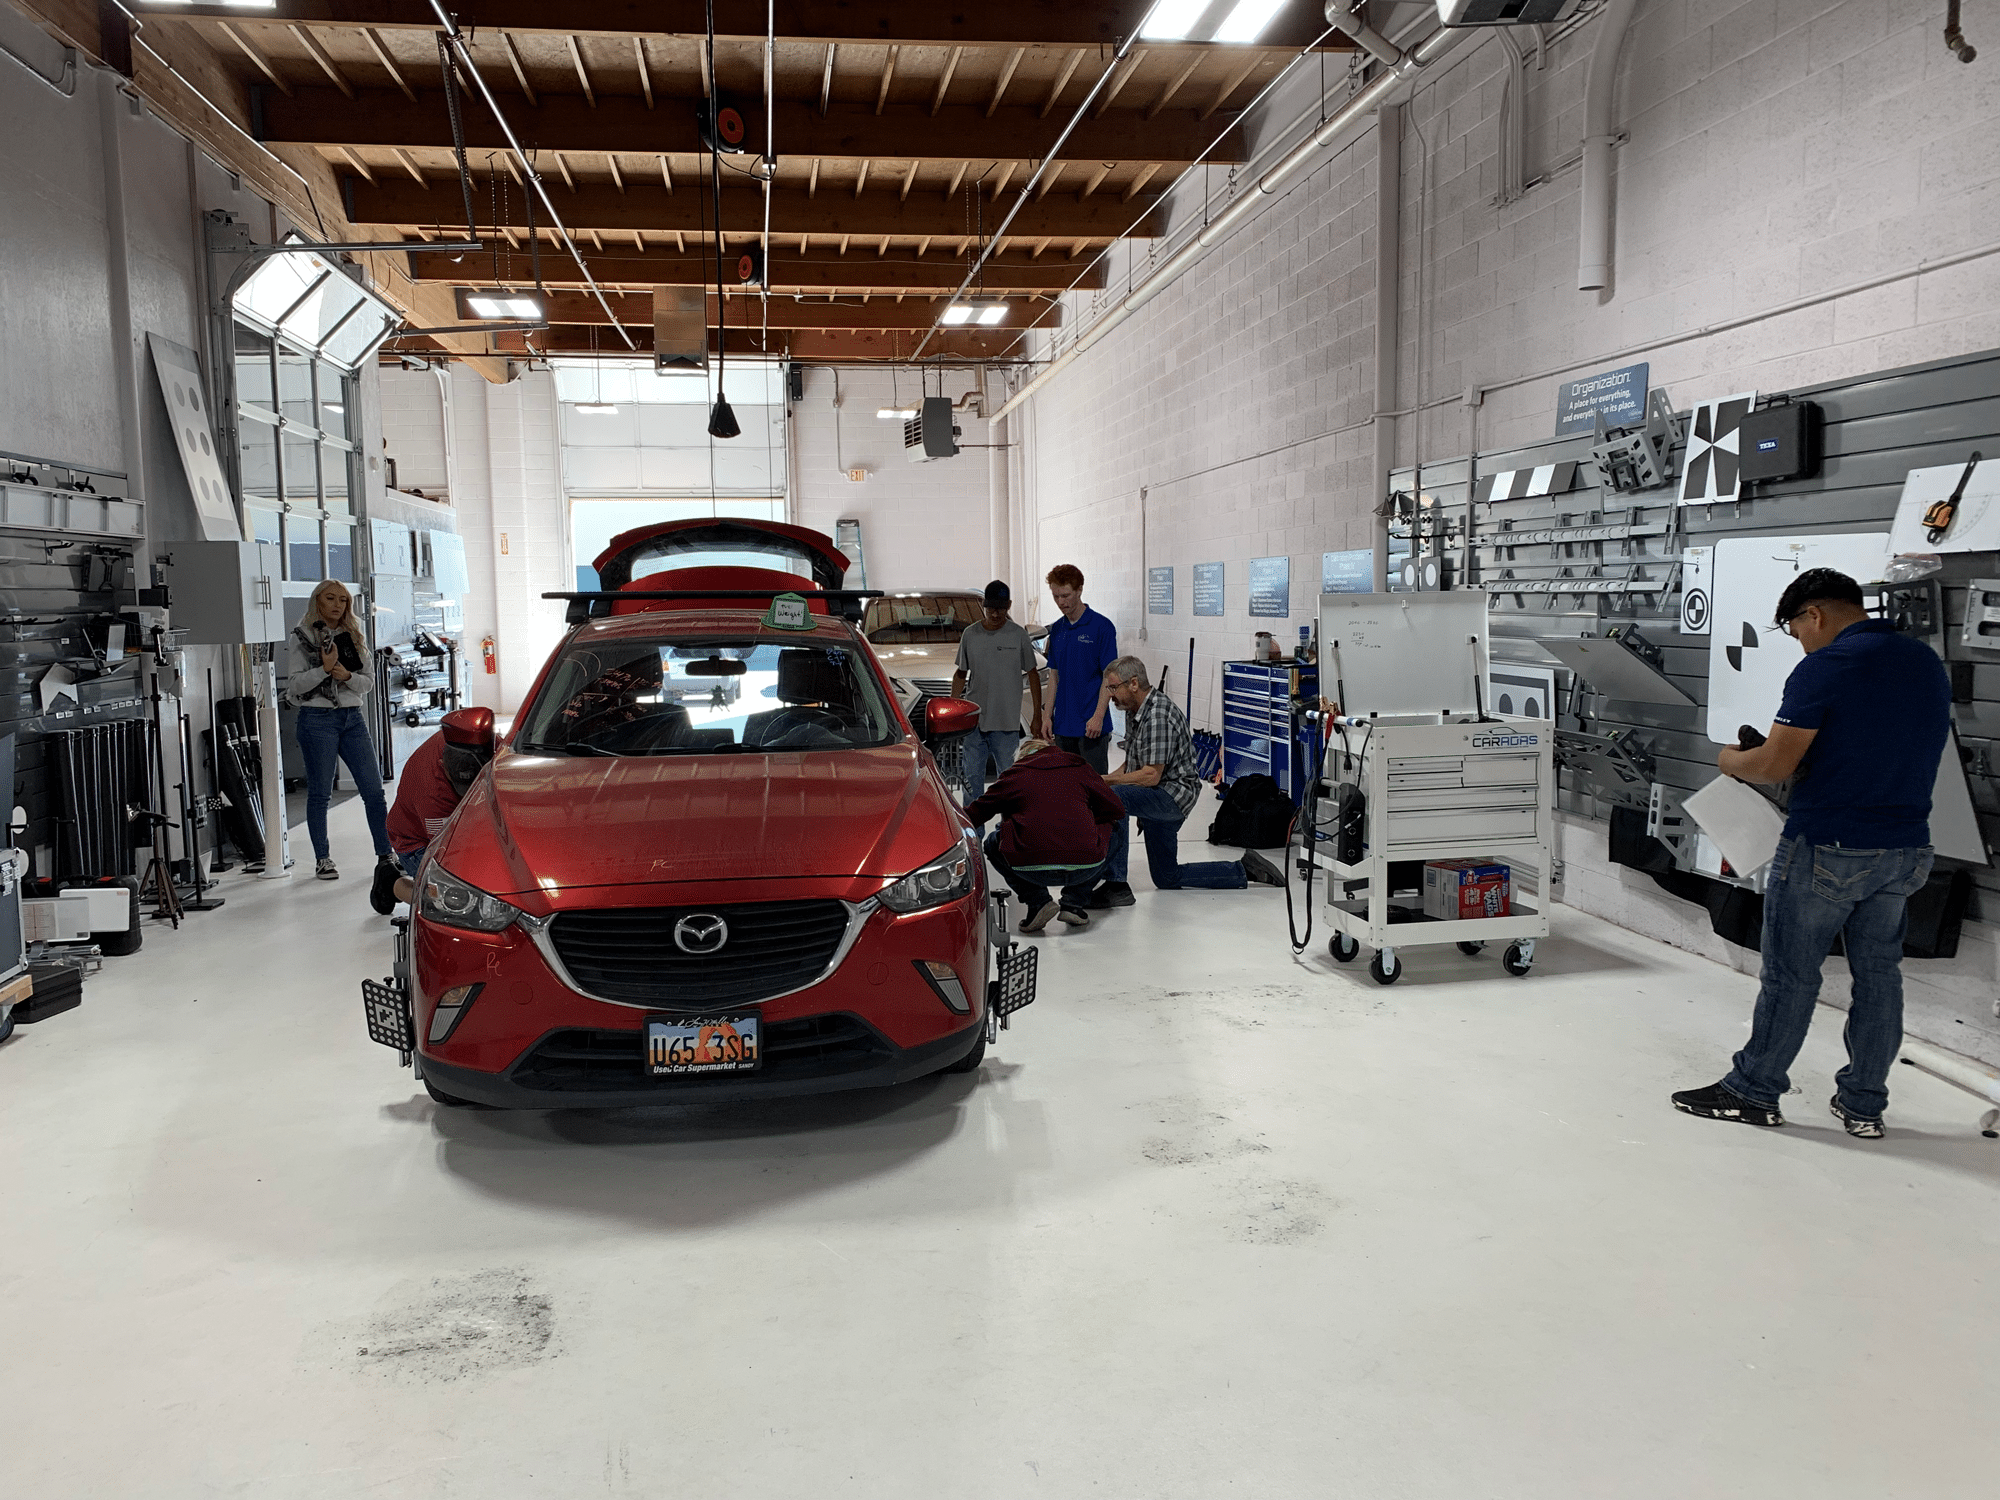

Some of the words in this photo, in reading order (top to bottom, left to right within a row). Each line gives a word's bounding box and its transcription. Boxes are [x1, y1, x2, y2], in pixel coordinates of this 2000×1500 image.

[1572, 371, 1632, 397] Organization:
[1568, 401, 1574, 411] A
[1574, 399, 1590, 410] place
[1590, 396, 1599, 405] for
[1598, 389, 1632, 403] everything,
[1563, 413, 1573, 423] and
[1573, 407, 1603, 421] everythi
[1603, 405, 1609, 414] in
[1610, 403, 1618, 412] its
[1618, 400, 1637, 413] place.
[1759, 441, 1776, 450] TEXA
[1472, 735, 1538, 748] CARADAS
[653, 1036, 696, 1066] U65
[712, 1033, 754, 1062] 3SG
[673, 1063, 687, 1073] Car
[687, 1061, 736, 1073] Supermarket
